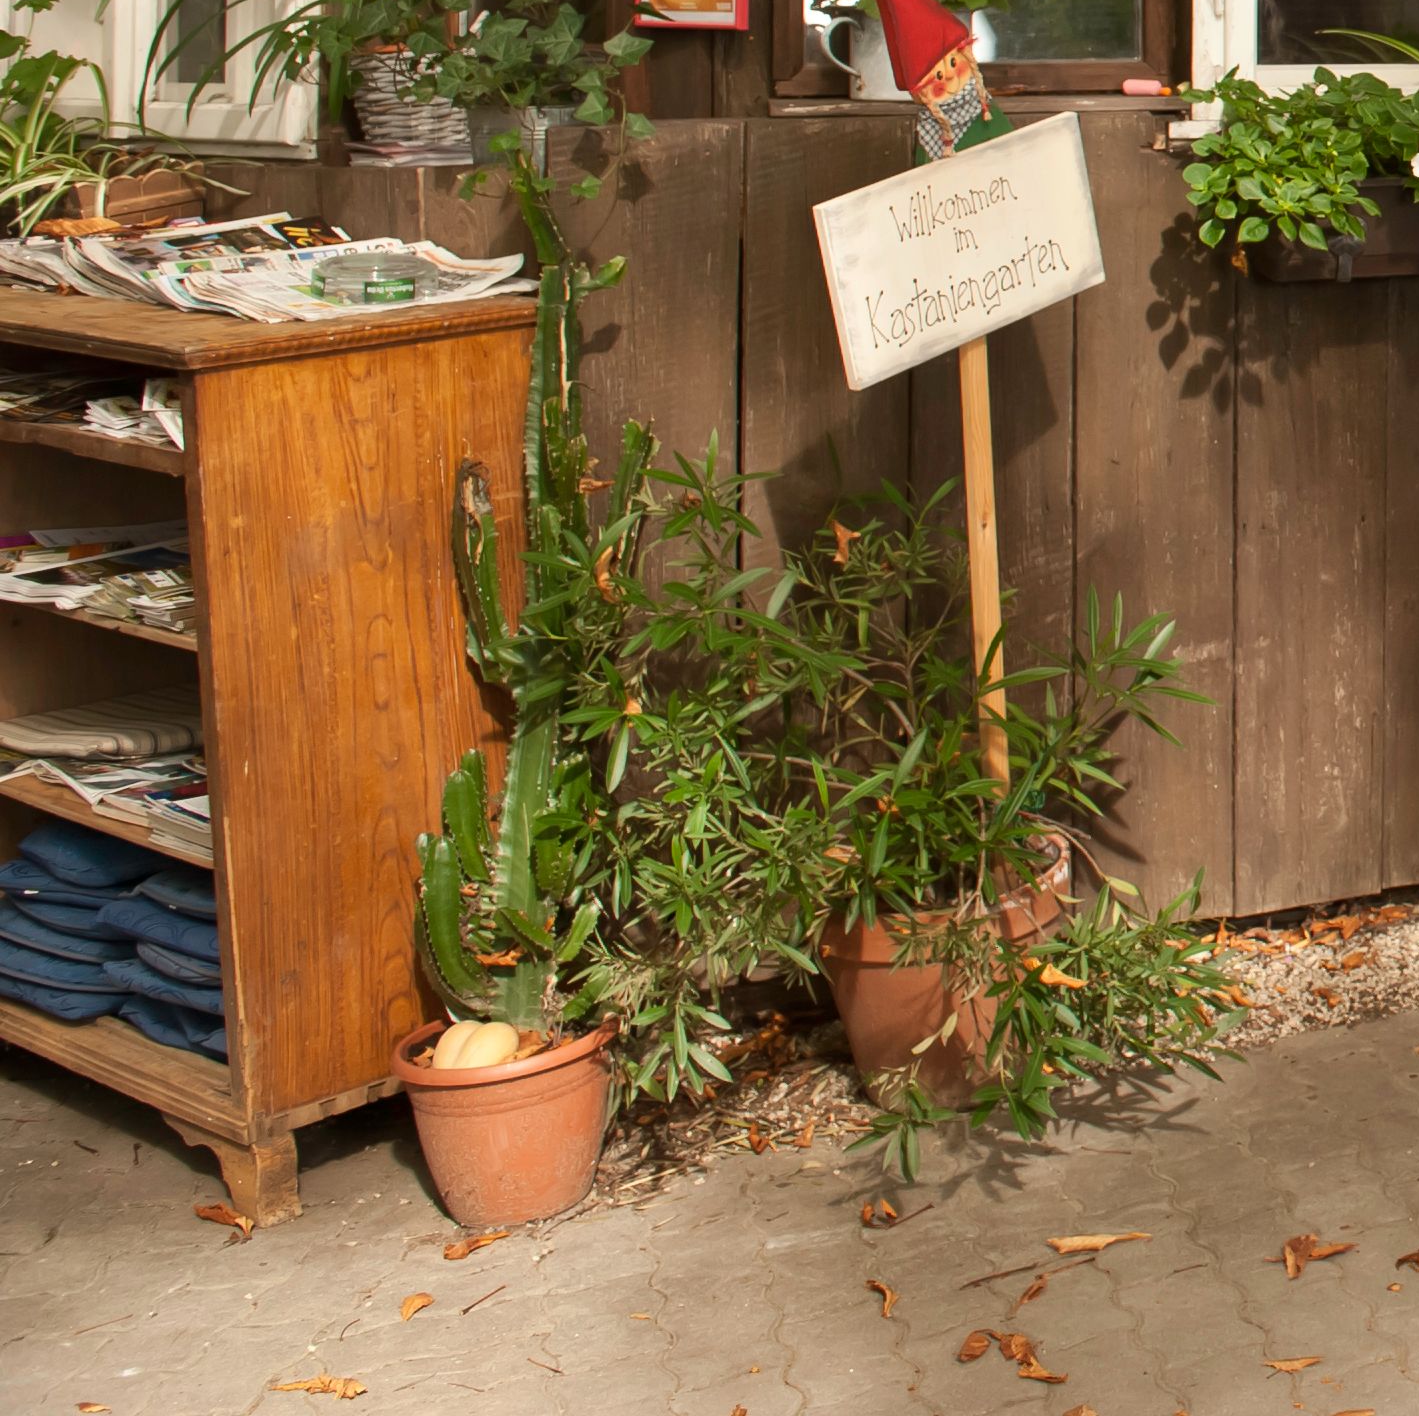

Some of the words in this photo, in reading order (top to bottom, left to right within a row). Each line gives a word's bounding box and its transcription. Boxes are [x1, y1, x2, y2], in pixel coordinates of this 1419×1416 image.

[889, 176, 1018, 242] Willkommen
[953, 227, 979, 253] im
[865, 236, 1070, 349] Kastaniengarten
